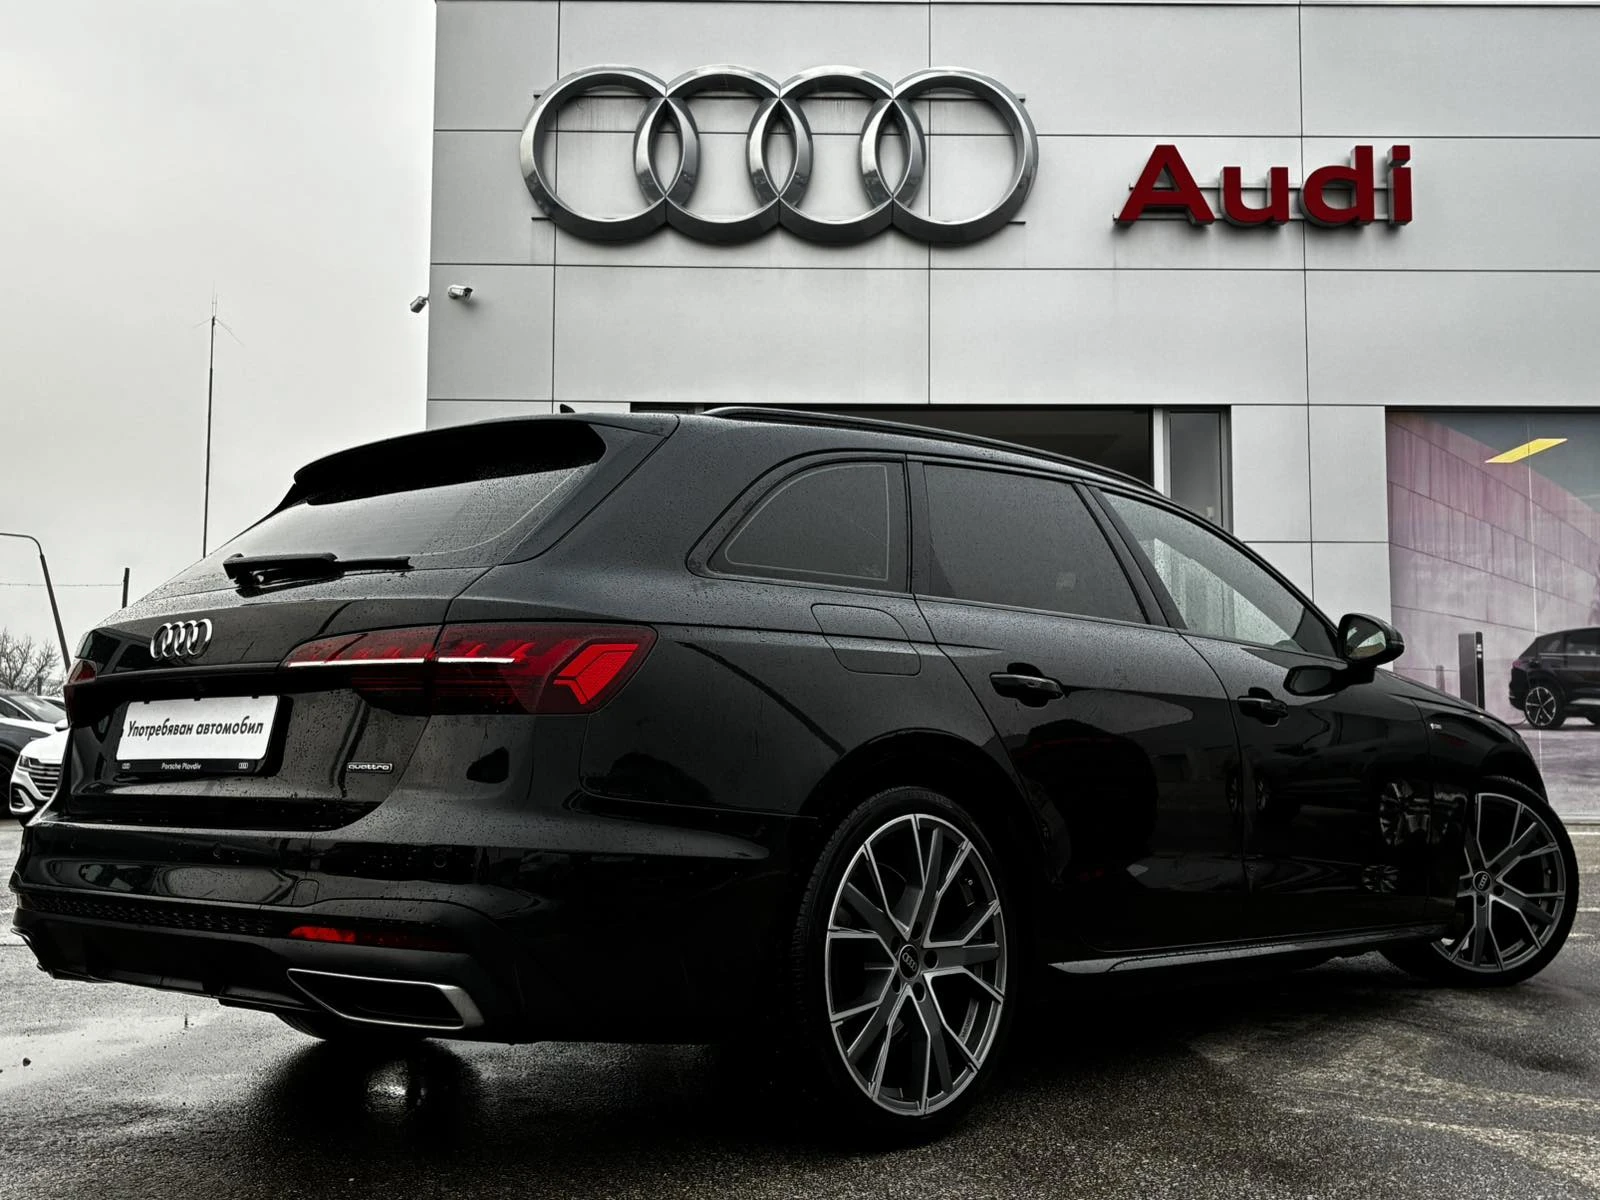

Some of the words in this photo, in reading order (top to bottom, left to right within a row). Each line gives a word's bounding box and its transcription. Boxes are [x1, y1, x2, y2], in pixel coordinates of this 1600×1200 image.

[1116, 144, 1413, 225] Audi
[127, 718, 194, 741] Употребяван
[195, 715, 264, 735] автомобил
[161, 762, 181, 770] Porsche
[182, 762, 202, 770] Plovdiv
[348, 763, 390, 771] quattro
